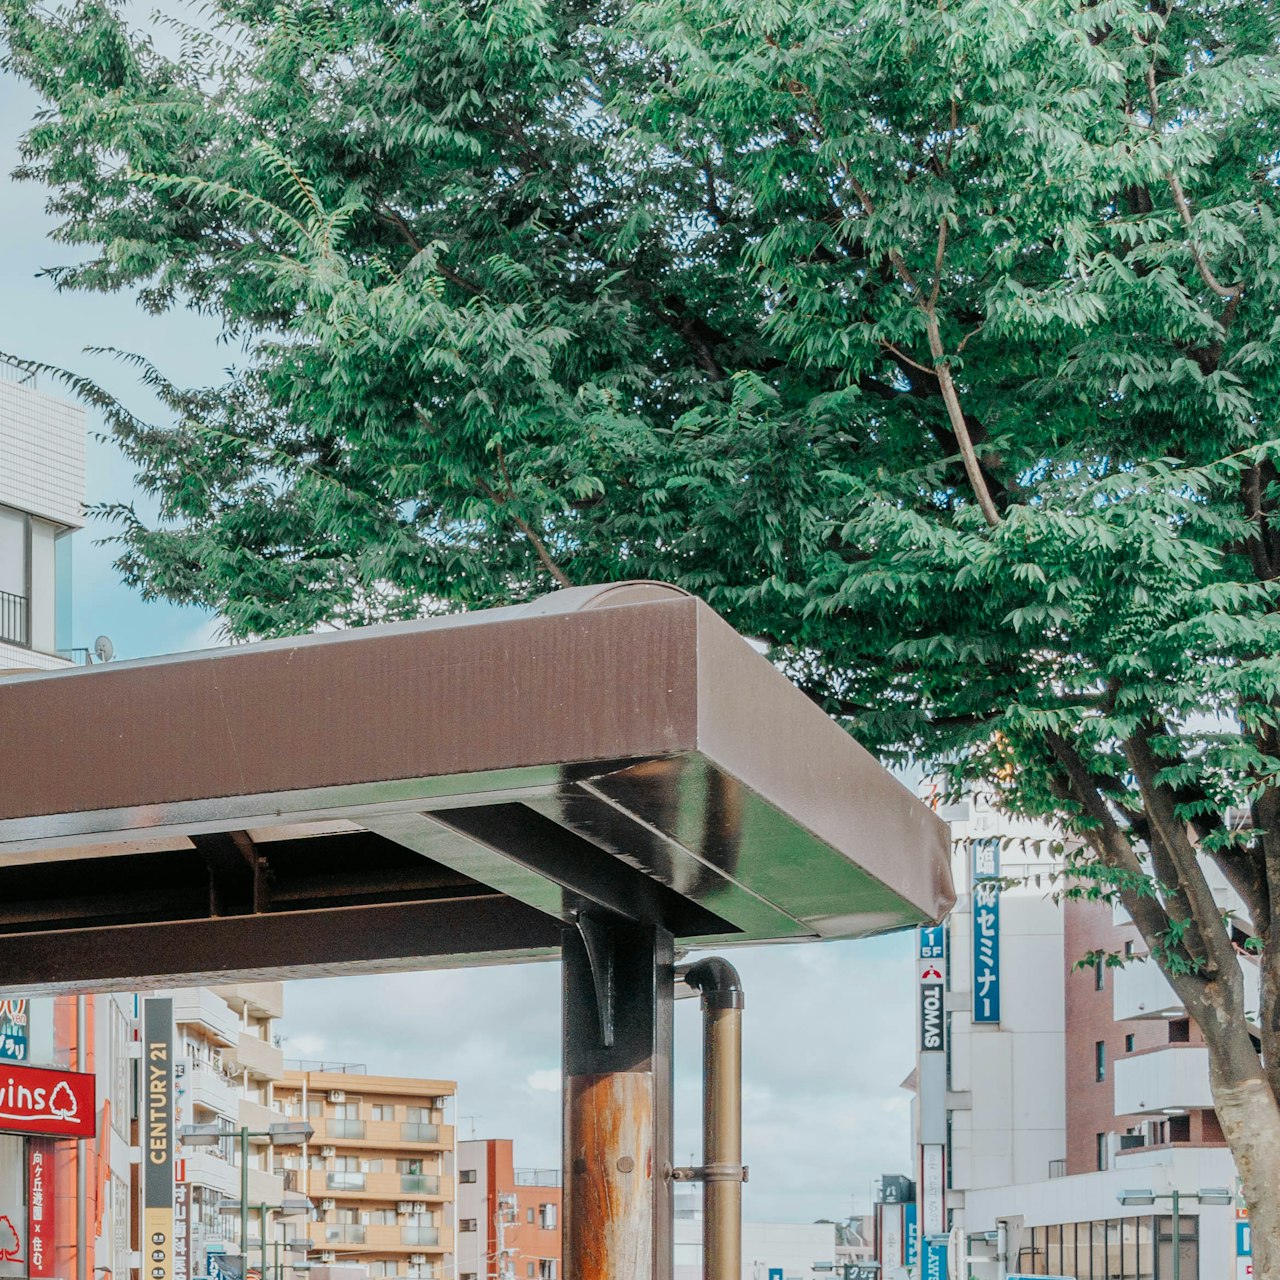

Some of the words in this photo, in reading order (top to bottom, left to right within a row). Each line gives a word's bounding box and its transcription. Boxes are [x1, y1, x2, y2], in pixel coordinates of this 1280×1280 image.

[922, 946, 942, 957] 5F
[924, 986, 941, 1048] TOMAS
[150, 1043, 167, 1061] 21
[150, 1065, 167, 1165] CENTURY
